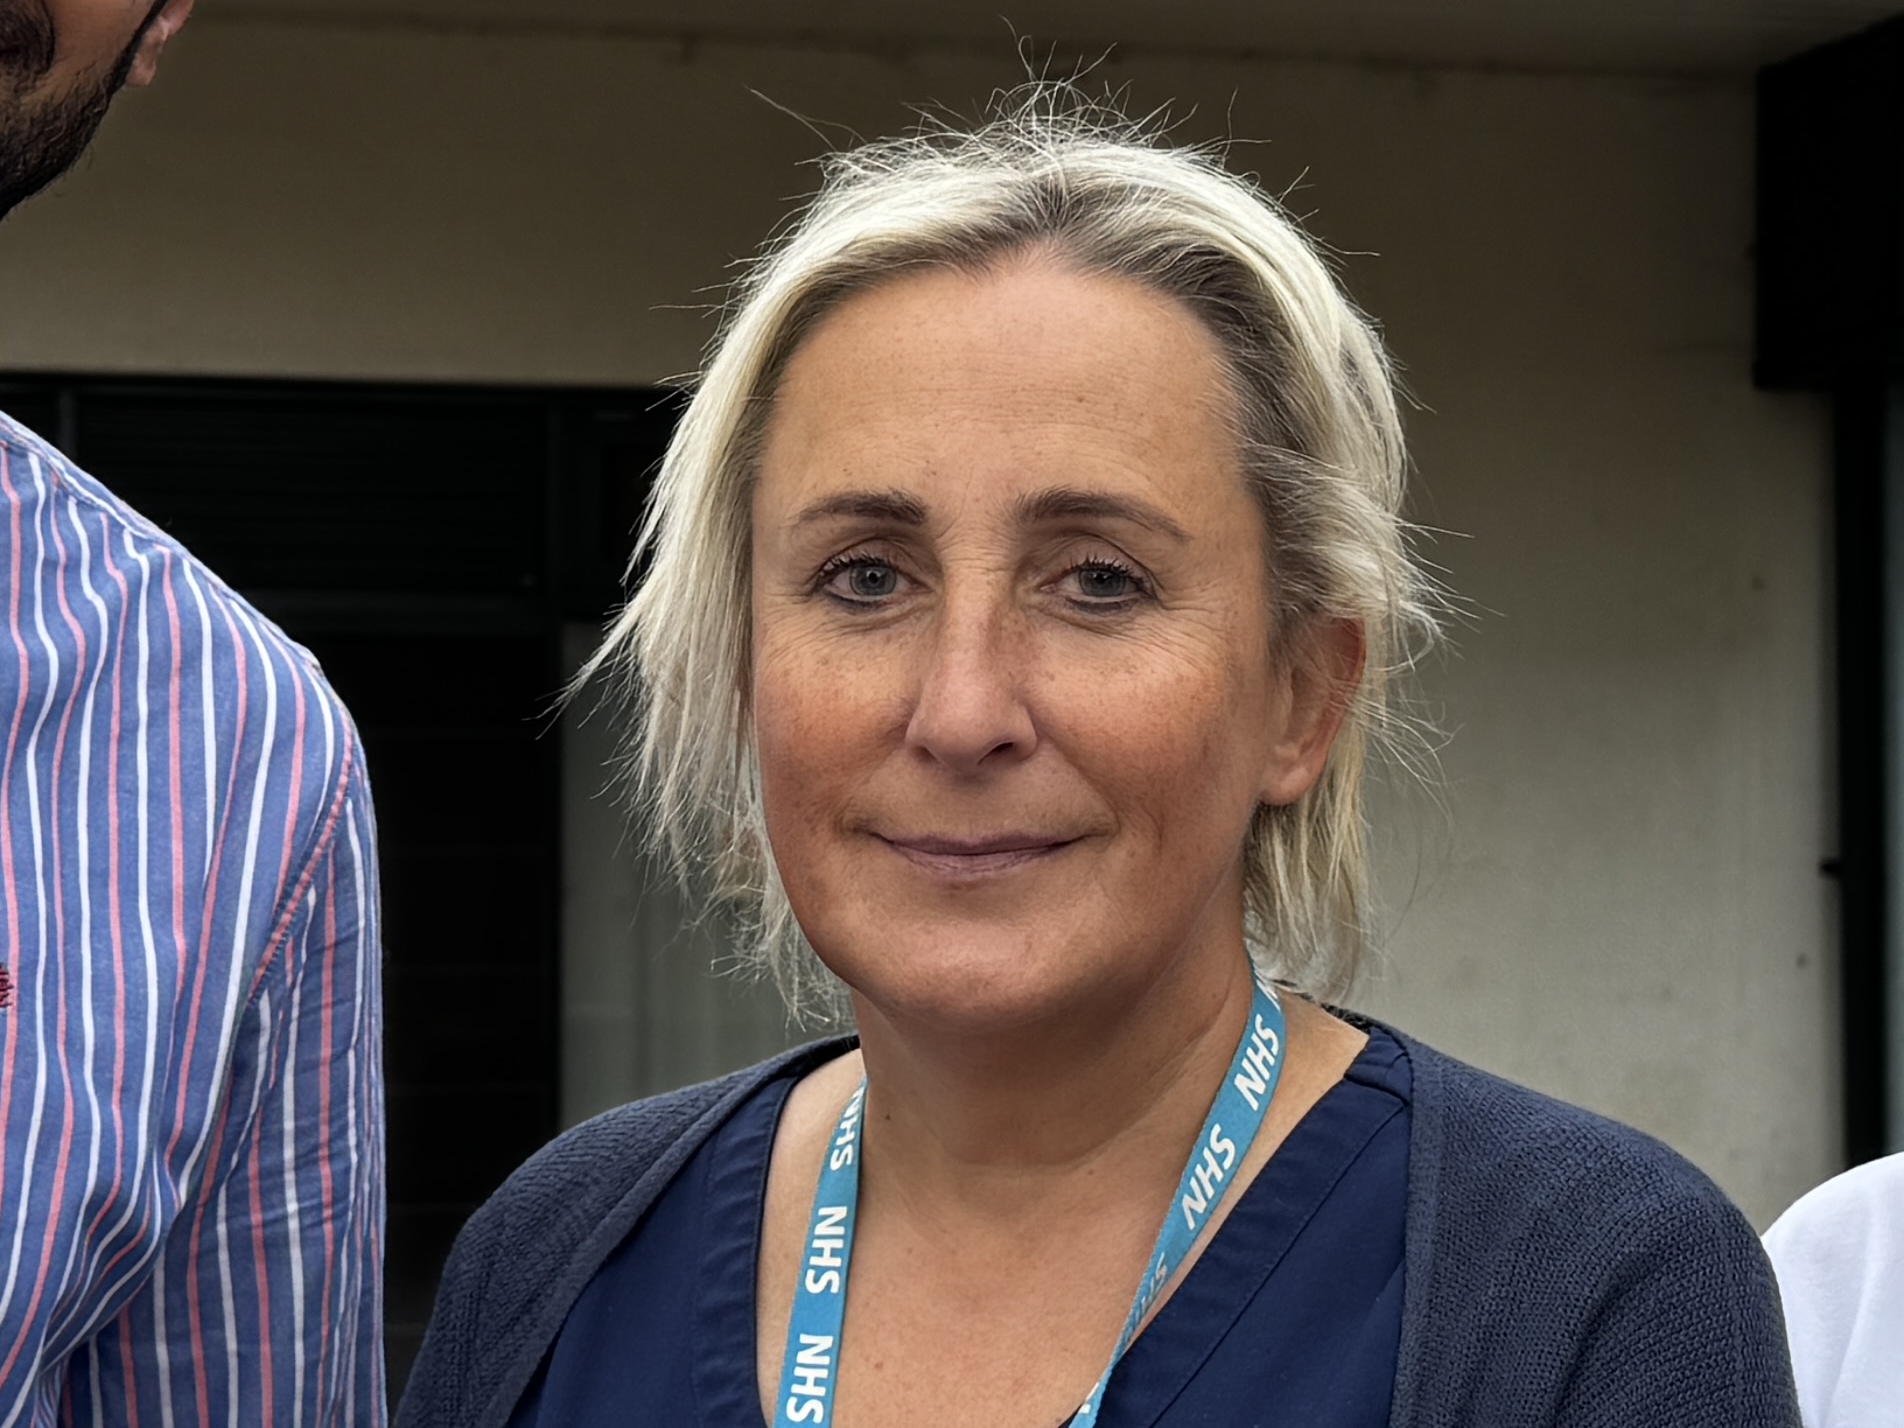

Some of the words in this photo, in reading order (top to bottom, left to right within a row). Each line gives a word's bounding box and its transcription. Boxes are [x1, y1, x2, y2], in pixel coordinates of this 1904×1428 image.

[1183, 1124, 1235, 1229] NHS
[1234, 1014, 1280, 1112] NHS
[806, 1207, 847, 1293] NHS
[787, 1334, 833, 1423] NHS
